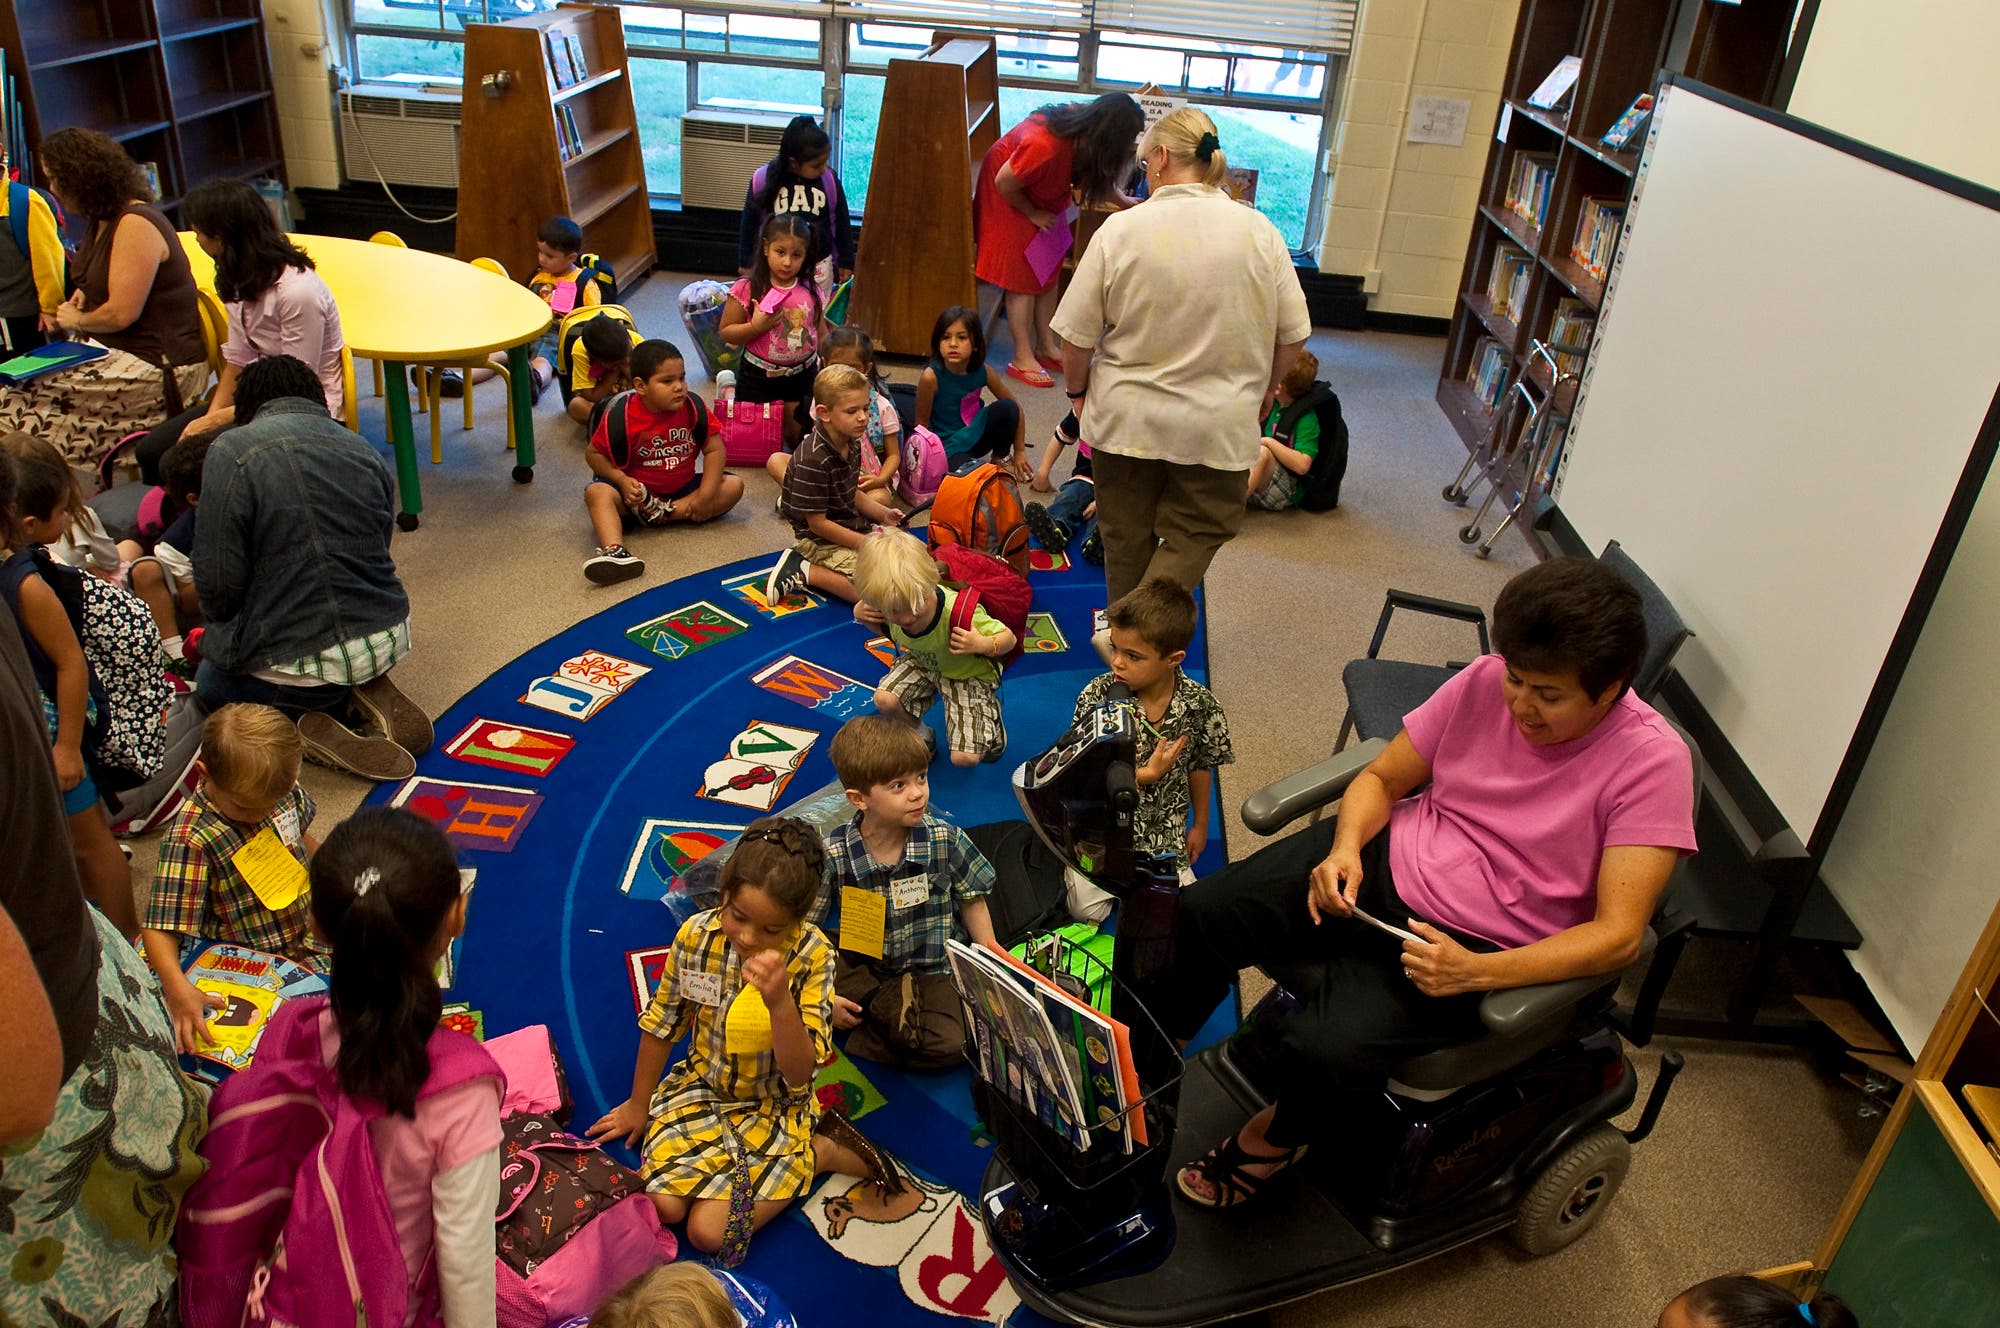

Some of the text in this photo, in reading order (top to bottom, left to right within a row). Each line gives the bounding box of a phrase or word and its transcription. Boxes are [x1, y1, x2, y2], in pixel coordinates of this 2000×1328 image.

[1141, 99, 1173, 108] READING
[774, 185, 826, 216] GAP
[669, 428, 697, 445] POL
[664, 609, 739, 645] K
[531, 677, 594, 712] J
[762, 663, 841, 700] W
[458, 741, 555, 772] I
[737, 726, 798, 757] V
[446, 796, 530, 842] H
[689, 980, 712, 992] Emilia
[918, 1205, 1007, 1317] R
